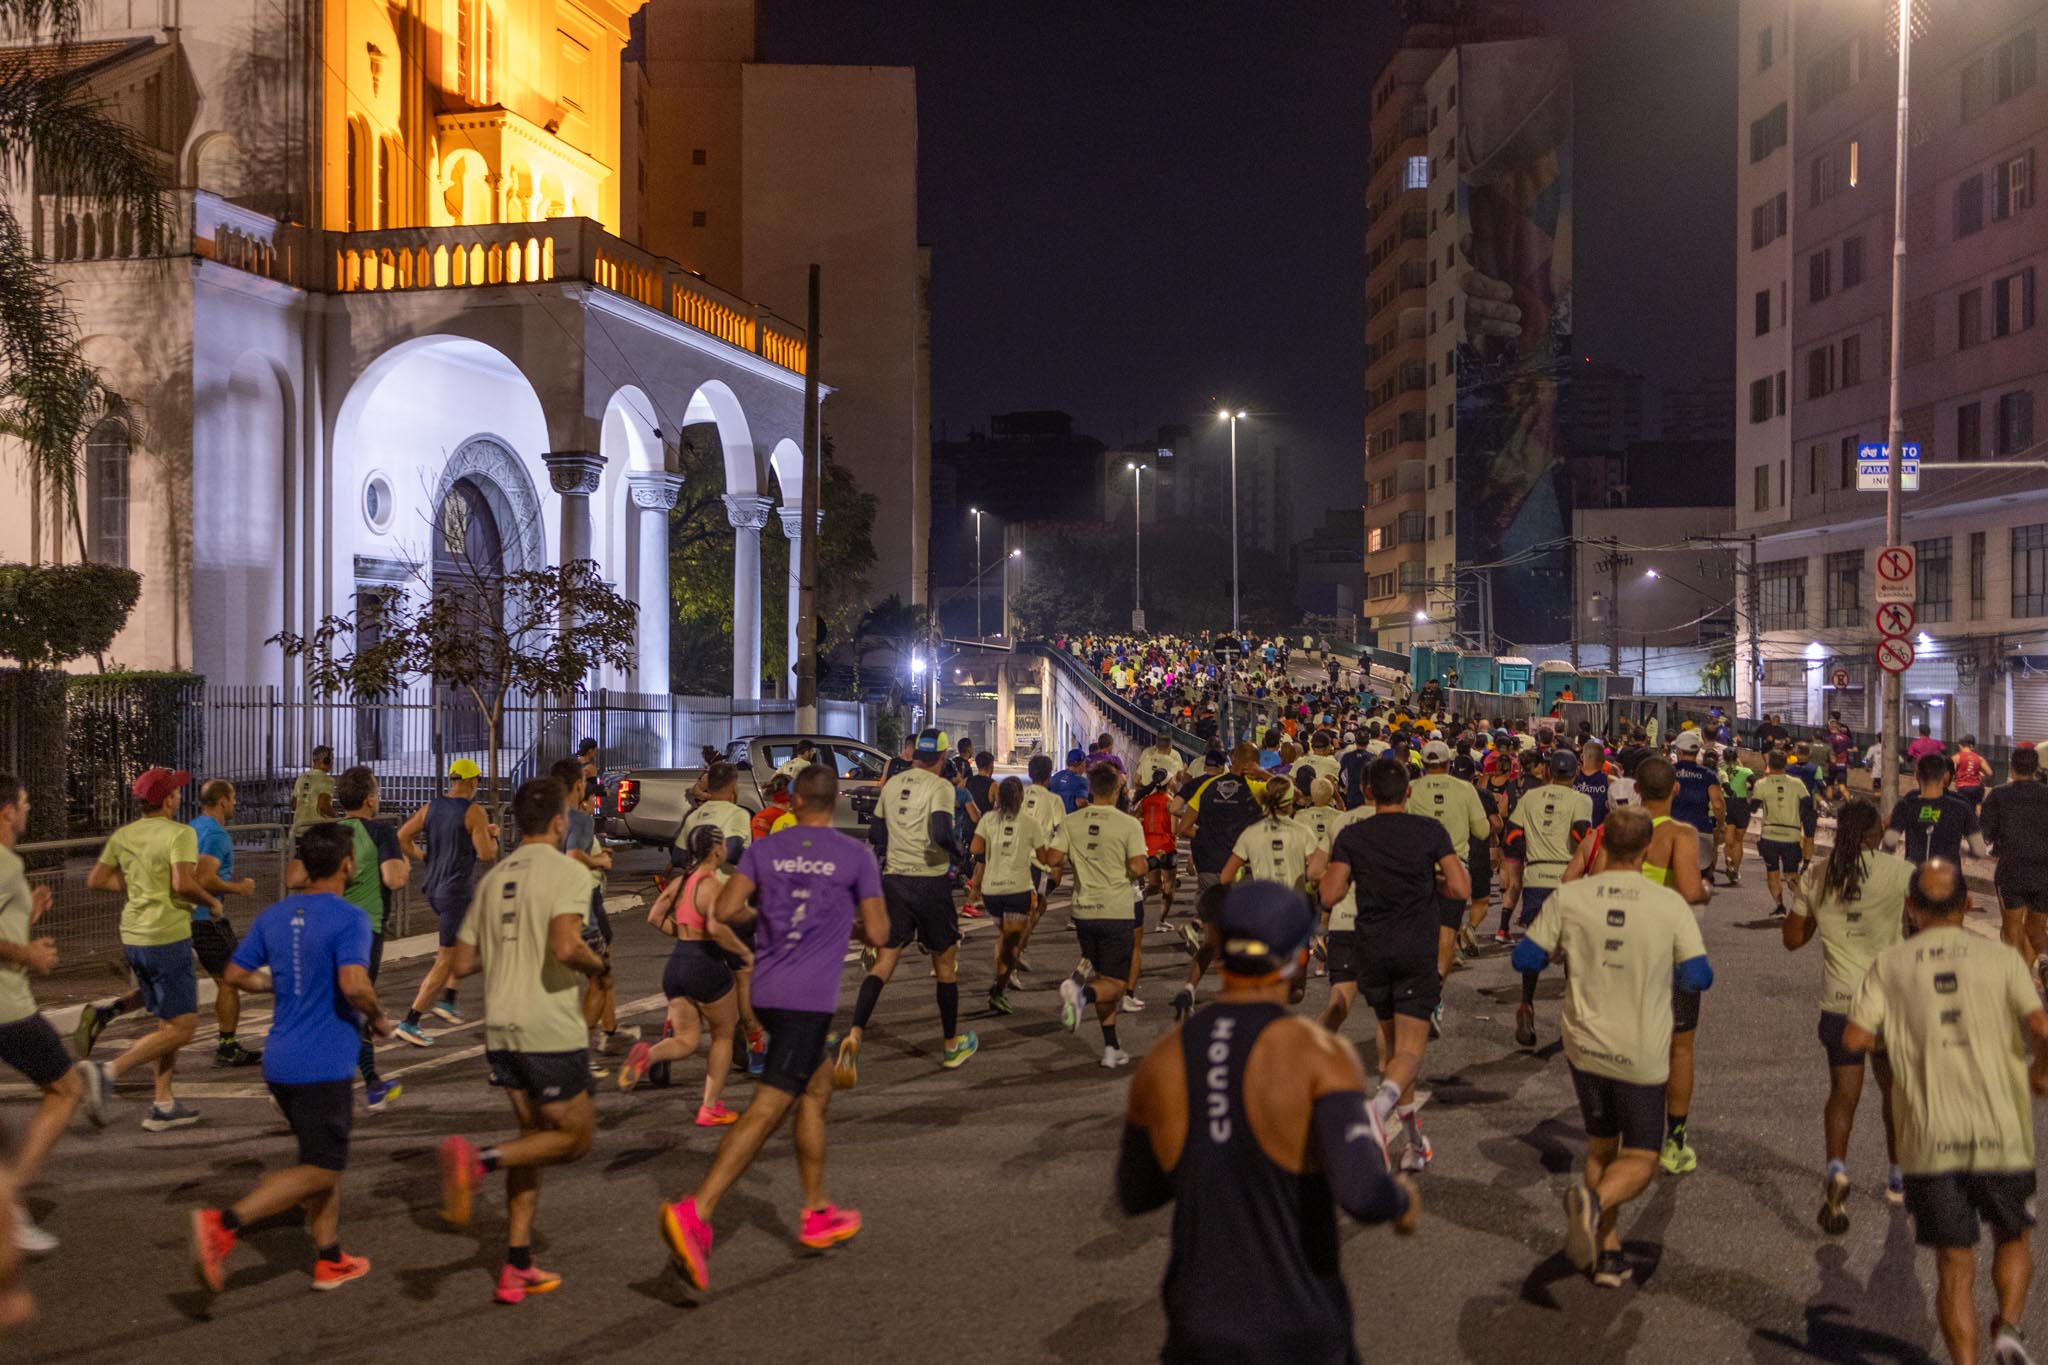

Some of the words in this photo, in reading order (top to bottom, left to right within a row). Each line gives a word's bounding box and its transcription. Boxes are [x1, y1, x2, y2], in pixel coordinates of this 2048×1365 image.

[1881, 446, 1917, 457] MTO
[1861, 466, 1889, 474] FAIXA
[773, 856, 836, 876] veloce
